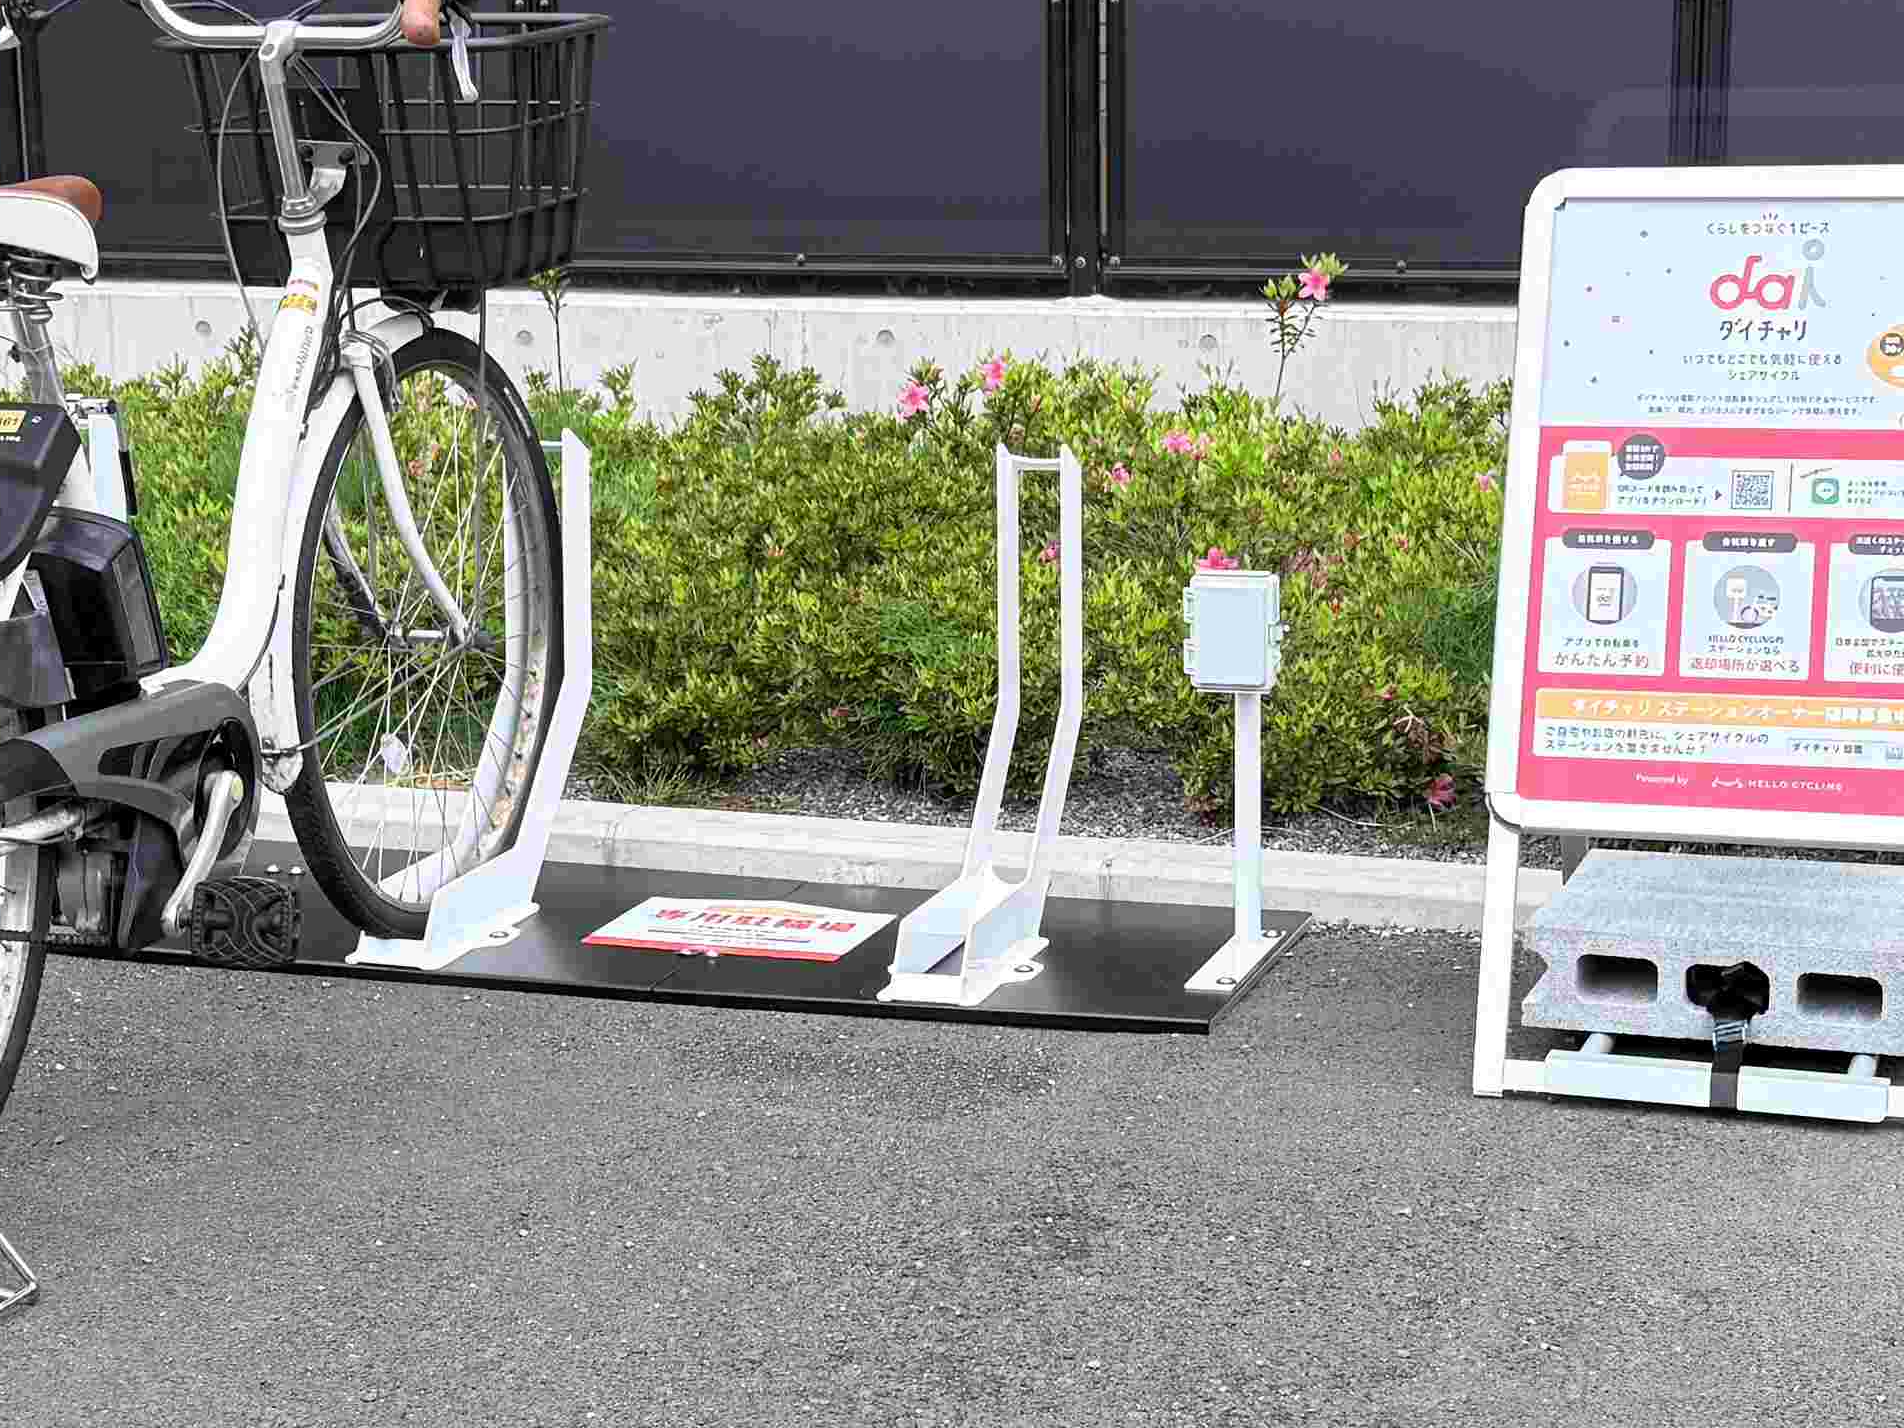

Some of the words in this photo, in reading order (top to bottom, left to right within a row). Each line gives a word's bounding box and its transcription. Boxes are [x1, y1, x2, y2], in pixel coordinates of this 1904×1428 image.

[1719, 318, 1807, 341] ダイチャリ
[1727, 370, 1800, 380] シェアサイクル
[1553, 653, 1649, 668] かんたん予約
[1748, 779, 1788, 789] HELLO
[1791, 780, 1844, 791] CYCLING
